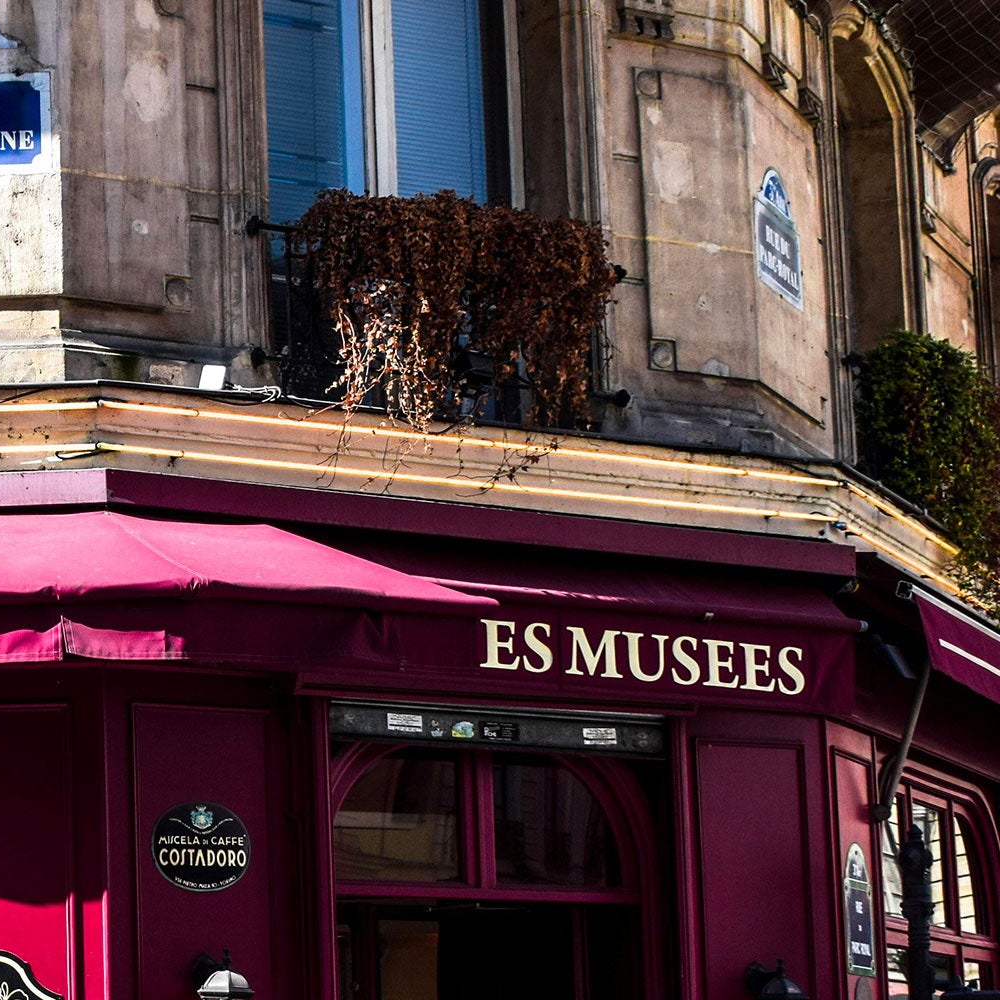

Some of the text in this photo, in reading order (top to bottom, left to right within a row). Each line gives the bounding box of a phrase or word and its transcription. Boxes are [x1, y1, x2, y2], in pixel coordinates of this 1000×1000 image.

[565, 626, 805, 695] MUSEES
[158, 835, 200, 845] MISCELA
[159, 848, 247, 867] COSTADORO
